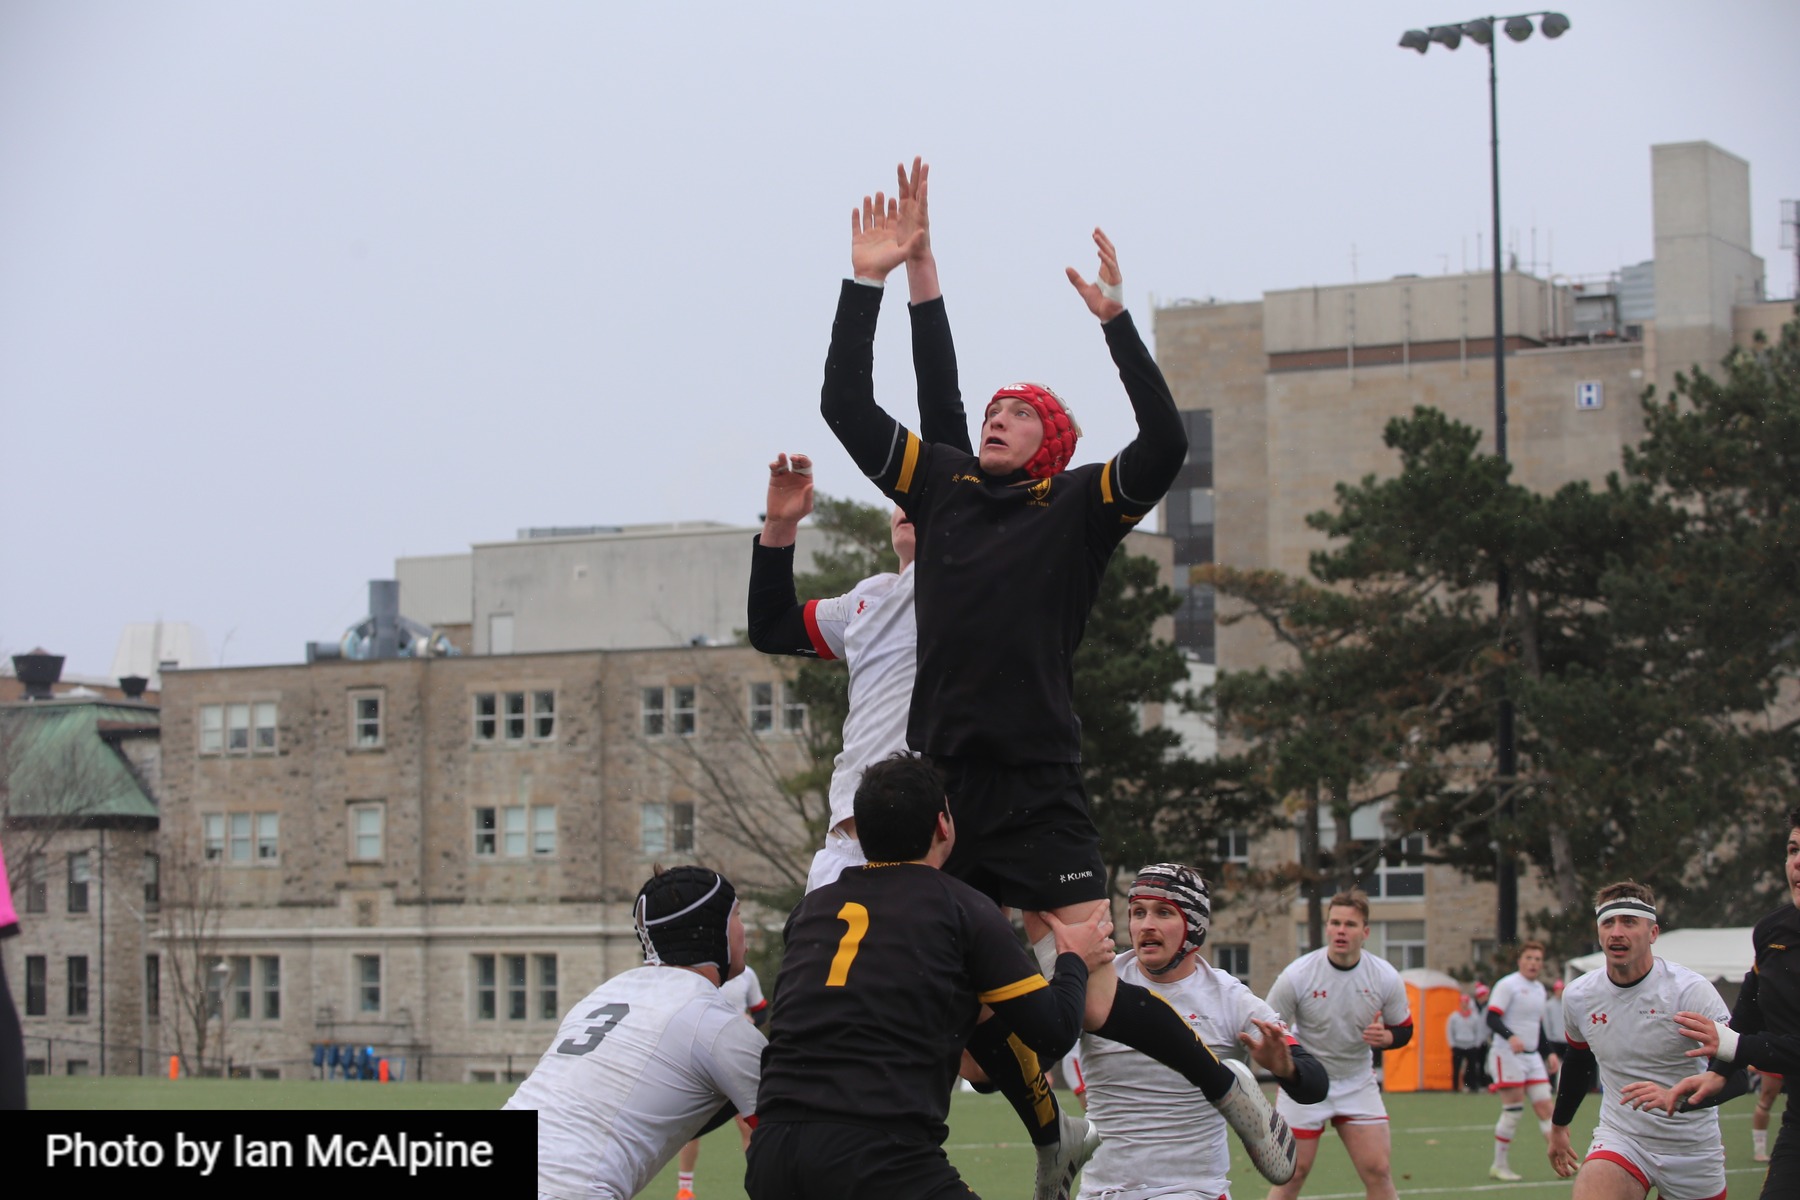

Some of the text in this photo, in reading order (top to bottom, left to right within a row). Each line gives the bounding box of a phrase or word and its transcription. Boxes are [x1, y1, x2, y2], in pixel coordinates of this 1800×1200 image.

[1580, 384, 1598, 407] H
[825, 902, 870, 986] 1
[557, 1003, 630, 1057] 3
